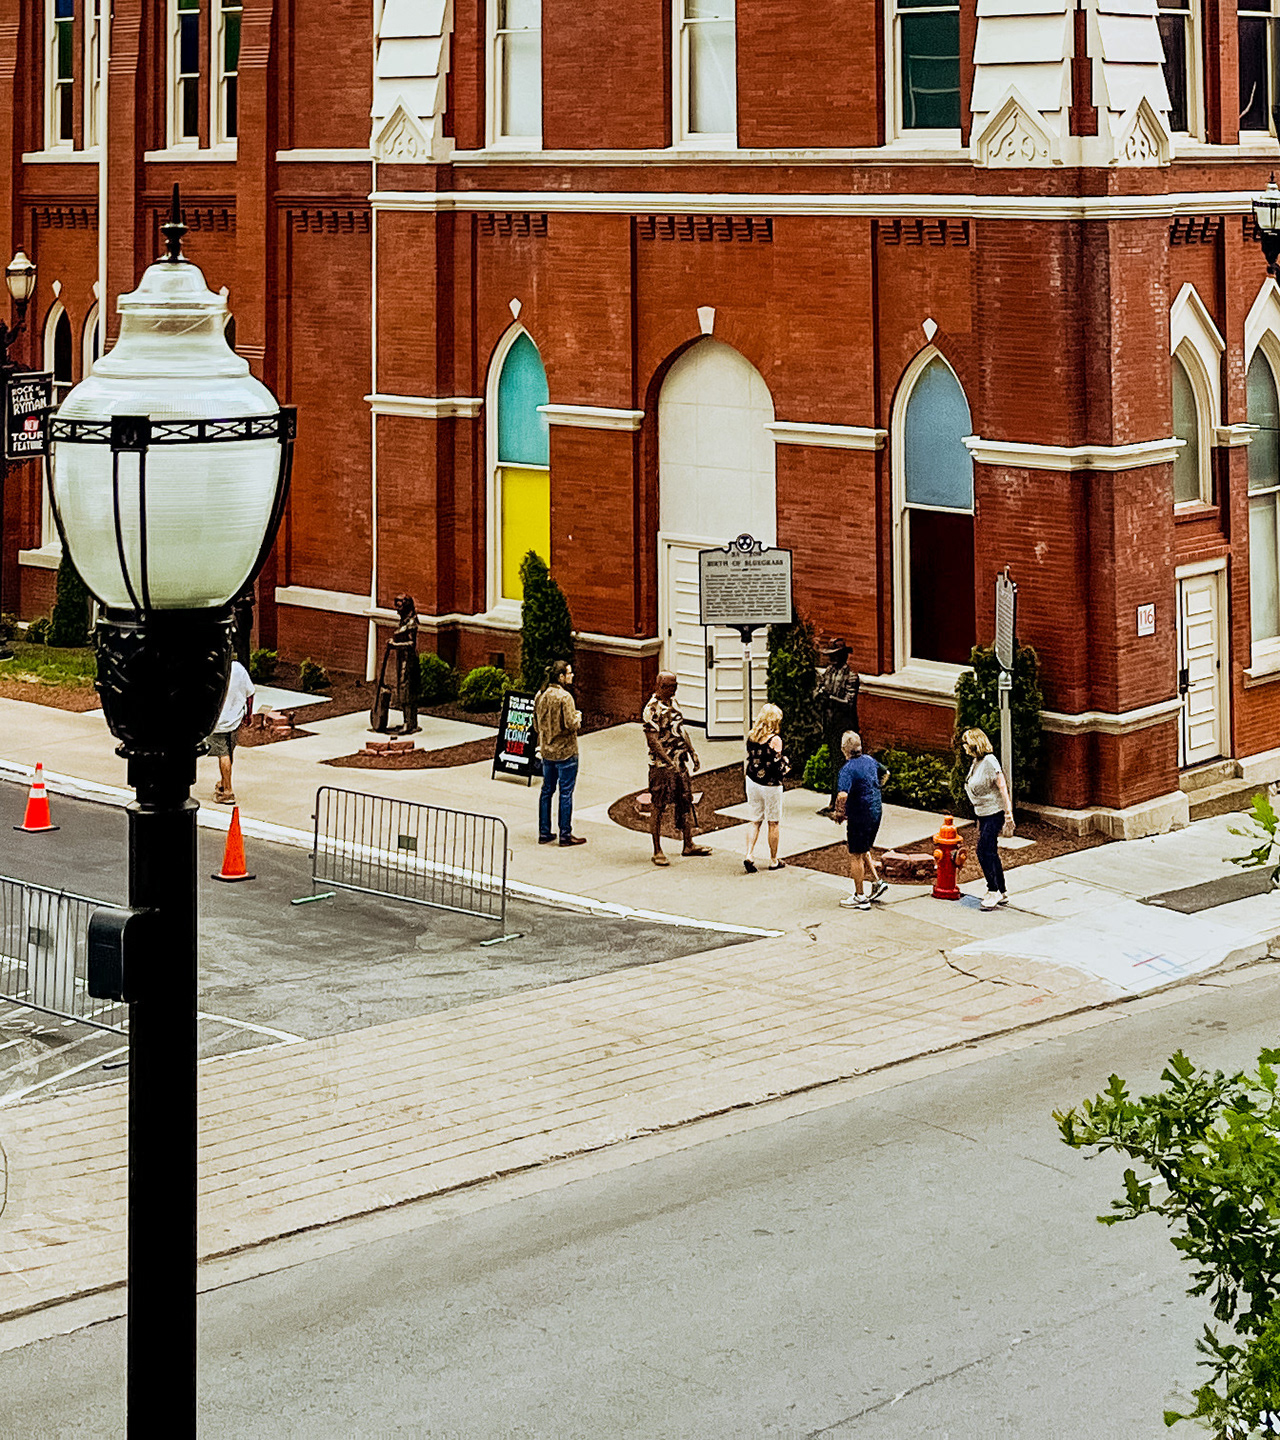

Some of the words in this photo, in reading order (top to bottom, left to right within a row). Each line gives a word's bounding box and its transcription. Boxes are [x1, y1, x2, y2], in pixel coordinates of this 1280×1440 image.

[11, 384, 34, 396] ROCK
[12, 392, 35, 404] HALL
[13, 396, 47, 416] RYMAN
[11, 431, 44, 441] TOUR
[707, 560, 729, 568] BIRTH
[1139, 608, 1154, 627] 116
[504, 728, 531, 744] ICONIC
